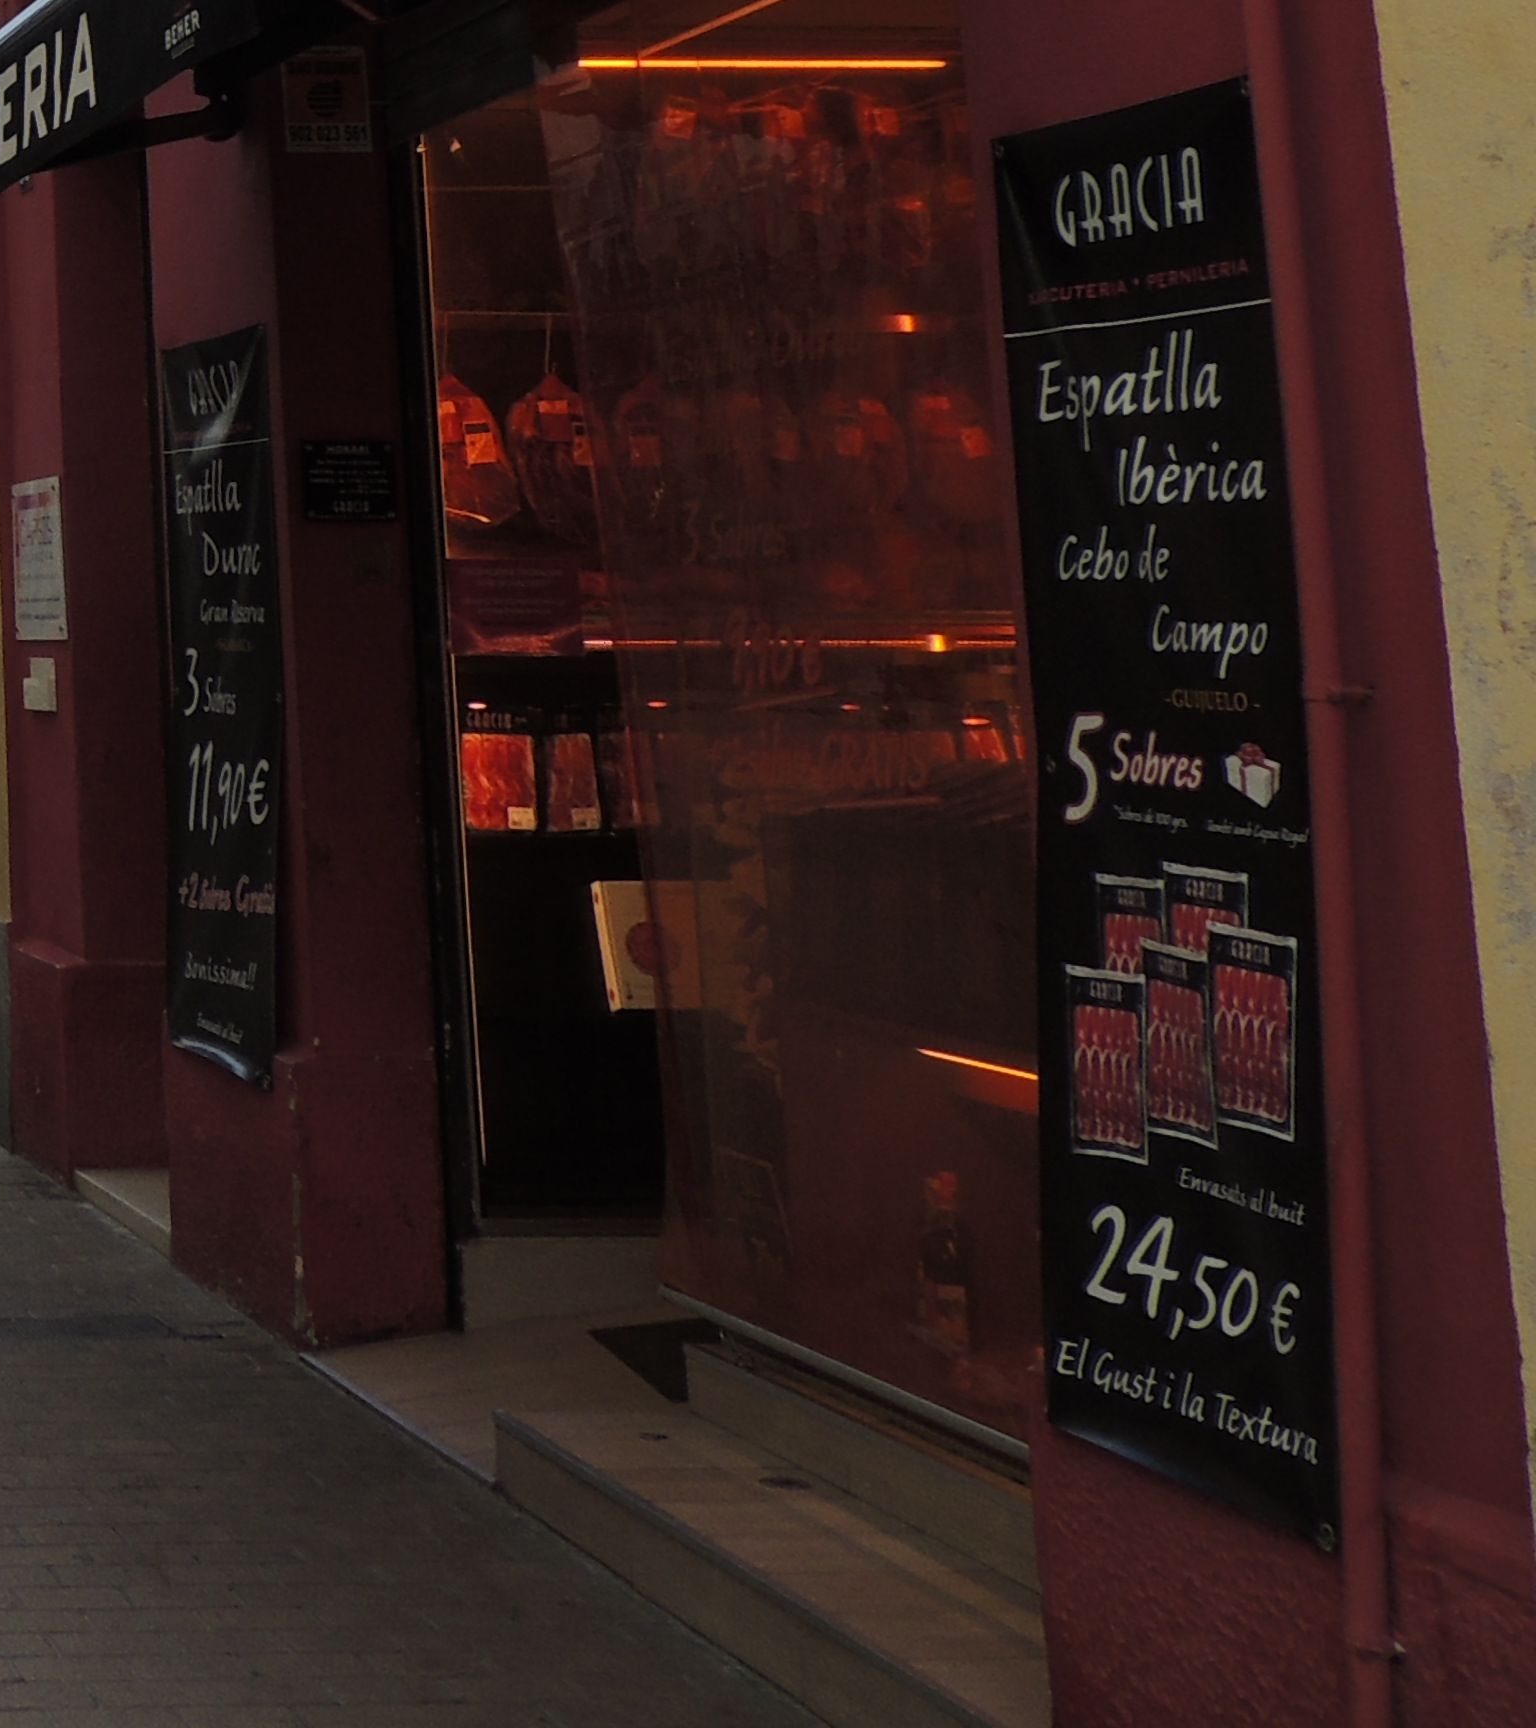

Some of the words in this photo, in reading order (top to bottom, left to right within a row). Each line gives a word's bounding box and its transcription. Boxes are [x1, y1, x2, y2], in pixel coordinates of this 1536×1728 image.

[1054, 145, 1206, 248] GRACIA
[1145, 258, 1249, 291] PERNILERIA
[1038, 327, 1223, 453] Espatlla
[175, 458, 243, 537] Espatlla
[1118, 434, 1269, 508] Ibèrica
[201, 530, 261, 577] Duroc
[1058, 524, 1132, 582] Cebo
[1137, 522, 1172, 584] de
[1151, 603, 1270, 680] Campo
[183, 647, 200, 716] 3
[1064, 715, 1106, 824] 5
[1109, 729, 1208, 792] Sobres
[1178, 1166, 1247, 1208] Envasats
[1249, 1187, 1265, 1214] al
[1268, 1189, 1306, 1227] buit
[1055, 1337, 1091, 1380] El
[1092, 1351, 1157, 1404] Gust
[1162, 1372, 1175, 1410] i
[1180, 1371, 1206, 1422] la
[1215, 1391, 1319, 1466] Textura
